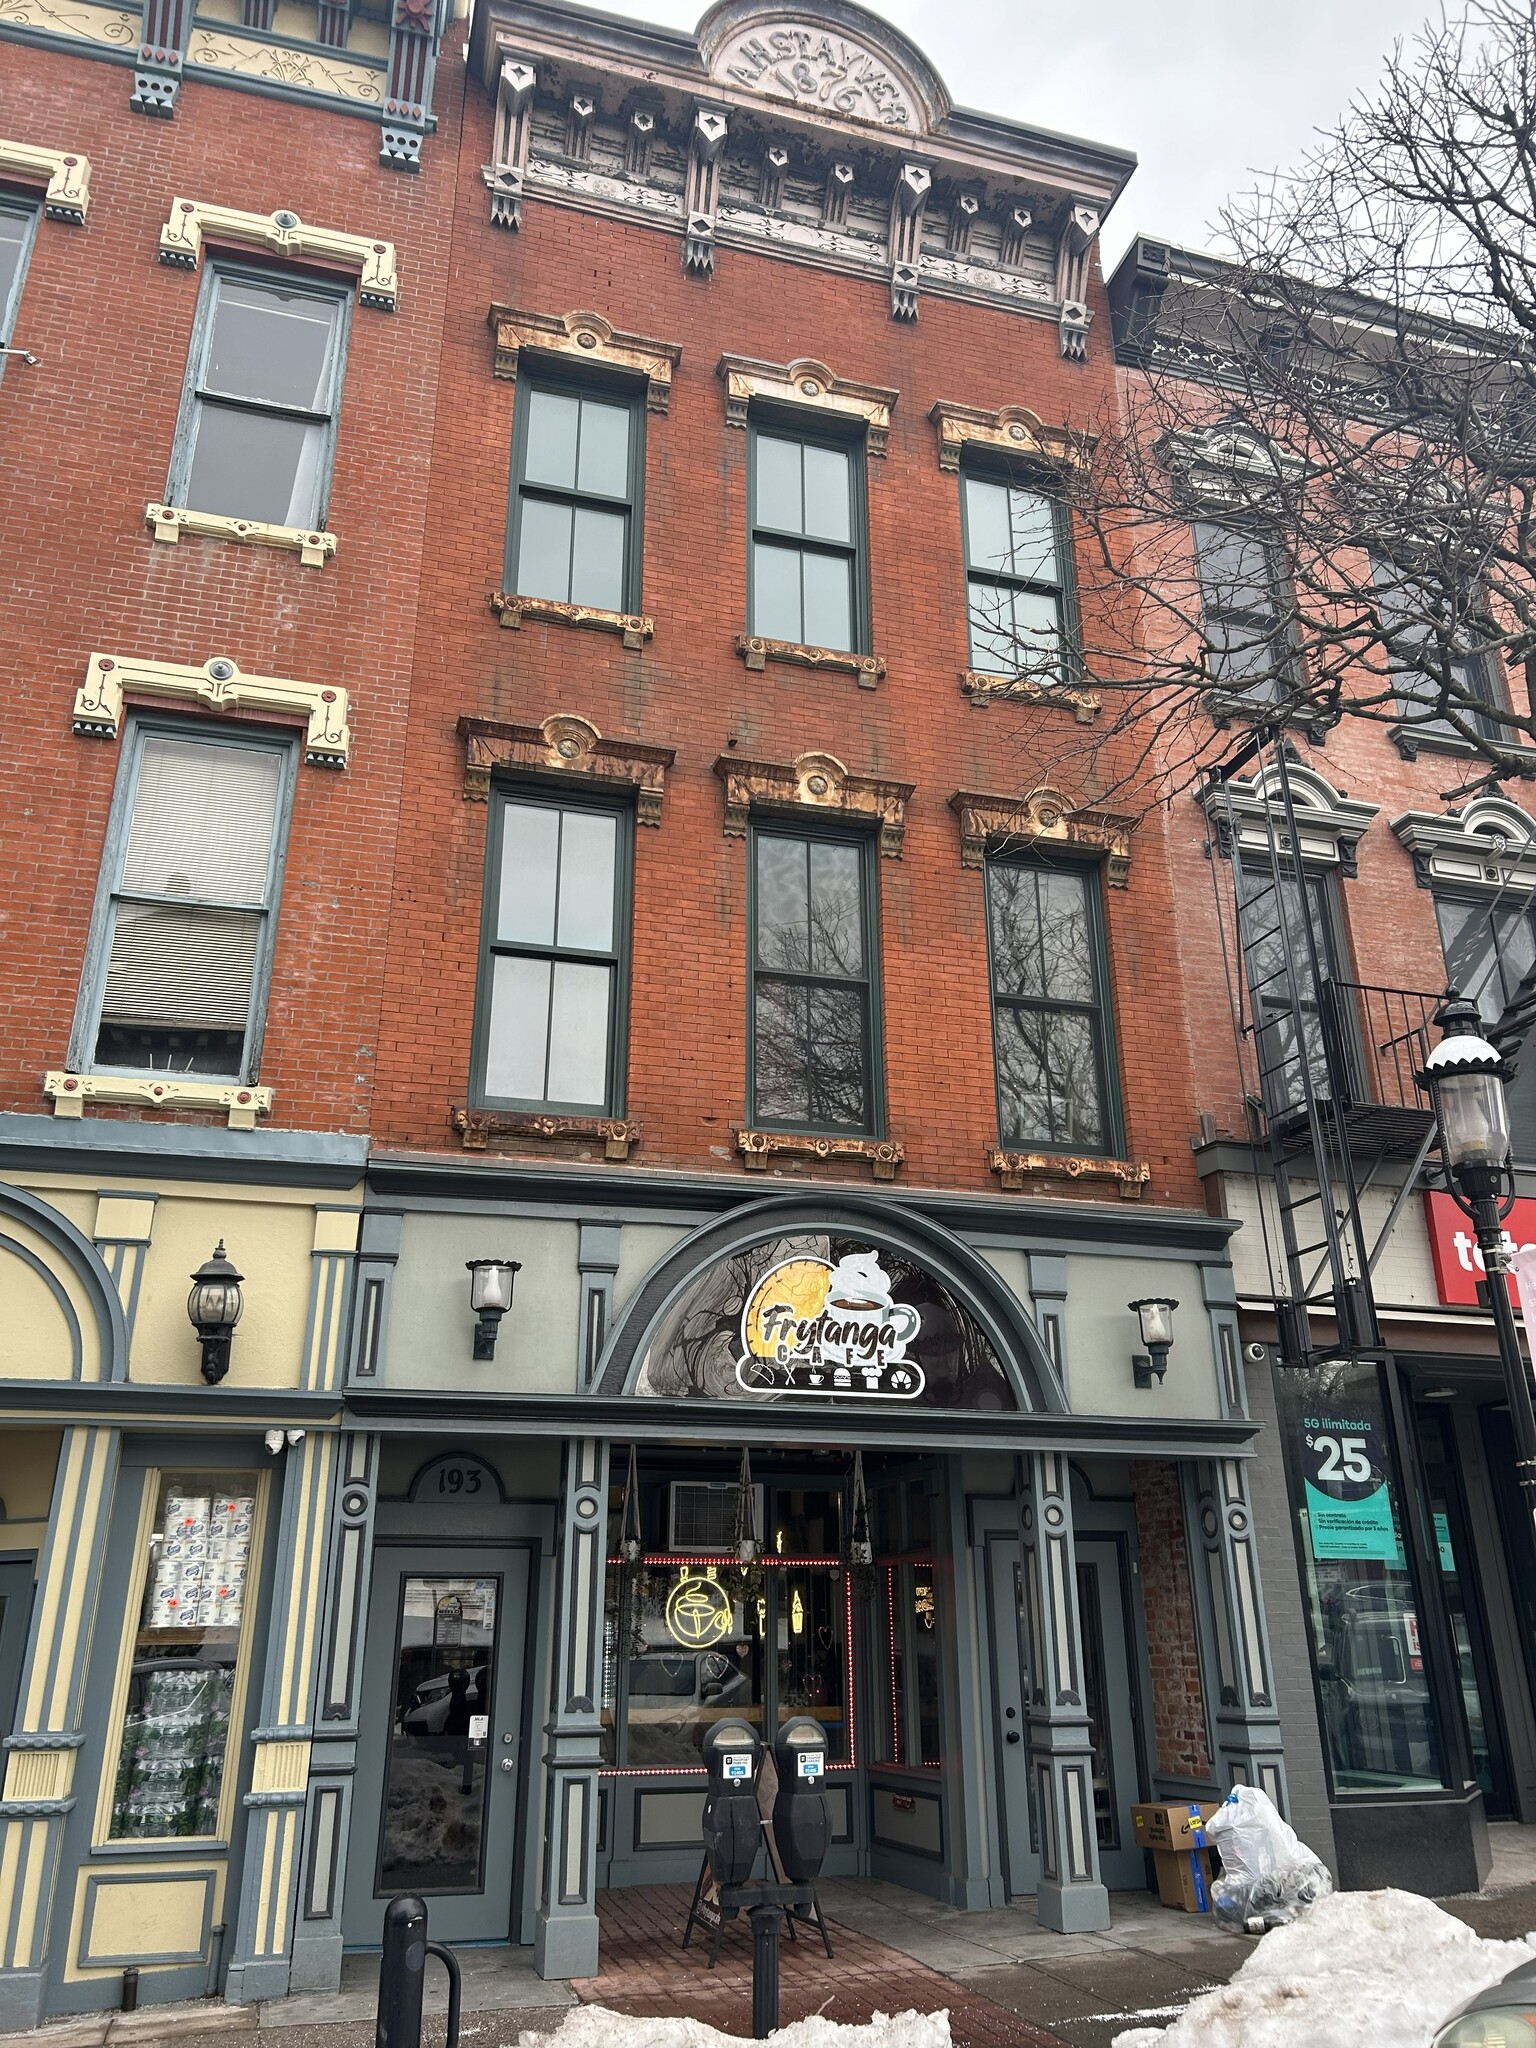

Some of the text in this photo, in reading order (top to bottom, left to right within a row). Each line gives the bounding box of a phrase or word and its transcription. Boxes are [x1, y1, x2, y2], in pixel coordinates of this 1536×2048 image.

[775, 62, 863, 113] 1876
[763, 1304, 897, 1361] Frytanga
[777, 1343, 886, 1367] CAFE
[1304, 1417, 1372, 1432] 5G ilimitada
[438, 1468, 482, 1494] 193
